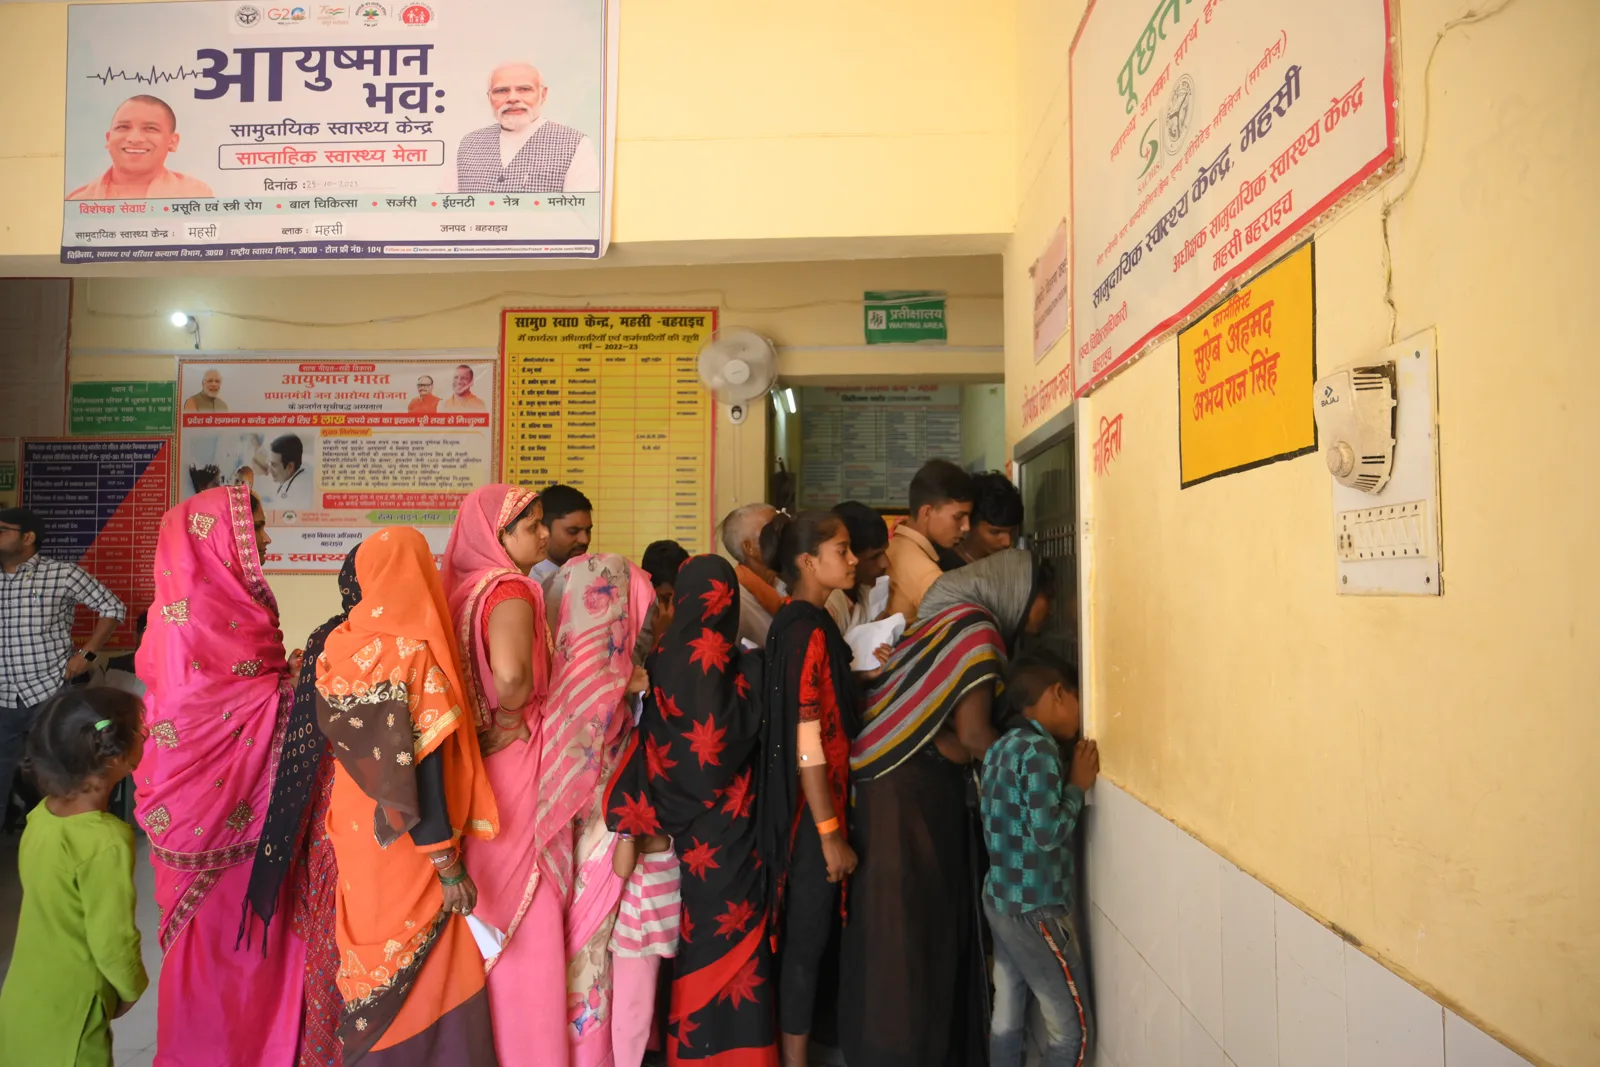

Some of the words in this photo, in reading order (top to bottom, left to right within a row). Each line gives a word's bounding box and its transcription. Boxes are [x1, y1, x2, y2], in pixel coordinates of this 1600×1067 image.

[194, 44, 434, 102] आयुष्मान
[1139, 63, 1171, 118] आपका
[1174, 18, 1200, 66] साथ
[230, 118, 320, 143] सामुदायिक
[327, 121, 389, 136] स्वास्थ्य
[396, 116, 434, 135] केन्द्र
[235, 146, 318, 166] साप्ताहिक
[324, 149, 386, 163] स्वास्थ्य
[392, 144, 428, 163] मेला
[1172, 221, 1208, 274] अधीक्षक
[1209, 172, 1267, 240] सामुदायिक
[1269, 119, 1321, 186] स्वास्थ्य
[1323, 77, 1366, 134] केन्द्र
[1091, 240, 1143, 311] सामुदायिक
[1145, 190, 1189, 254] स्वास्थ्य
[1191, 142, 1235, 203] केन्द्र,
[1240, 64, 1303, 153] महसी
[79, 202, 115, 216] विशेषज्ञ
[119, 201, 147, 214] सेवाएं
[171, 201, 200, 217] प्रसूति
[204, 199, 219, 212] एवं
[222, 199, 240, 213] स्त्री
[244, 199, 262, 212] रोग
[289, 199, 310, 211] बाल
[314, 196, 358, 210] चिकित्सा
[386, 195, 417, 209] सर्जरी
[442, 195, 475, 208] ईएनटी
[503, 195, 520, 208] नेत्र
[547, 195, 585, 208] मनोरोग
[75, 229, 117, 244] सामुदायिक
[120, 230, 148, 241] स्वास्थ्य
[188, 224, 217, 239] महसी
[315, 222, 344, 236] महसी
[440, 224, 466, 234] जनपद
[475, 224, 508, 234] बहराइच
[1212, 228, 1243, 273] महसी
[1244, 189, 1294, 247] बहराइच
[367, 245, 381, 254] 104
[620, 314, 651, 328] महसी
[890, 306, 942, 321] प्रतीक्षालय
[888, 321, 921, 329] WAITING
[923, 321, 944, 329] AREA
[1226, 299, 1276, 357] अहमद
[667, 333, 679, 342] की
[281, 374, 350, 388] आयुष्मान
[354, 374, 390, 385] भारत
[1192, 377, 1225, 422] अभय
[1224, 368, 1248, 404] राज
[1249, 347, 1281, 397] सिंह
[264, 390, 312, 400] प्रधानमंत्री
[314, 391, 332, 400] जन
[334, 390, 370, 400] आरोग्य
[373, 390, 407, 400] योजना
[1320, 395, 1340, 408] BAJAJ
[288, 402, 296, 410] के
[353, 402, 383, 410] अस्पताल
[205, 415, 213, 424] के
[214, 415, 240, 424] लगभग
[287, 414, 295, 424] के
[312, 413, 318, 424] 5
[321, 413, 345, 424] लाख
[367, 415, 380, 424] तक
[382, 415, 392, 424] का
[394, 415, 415, 425] इलाज
[417, 414, 429, 426] पूरी
[430, 415, 445, 425] तरह
[447, 414, 454, 424] से
[1092, 412, 1124, 478] महिला
